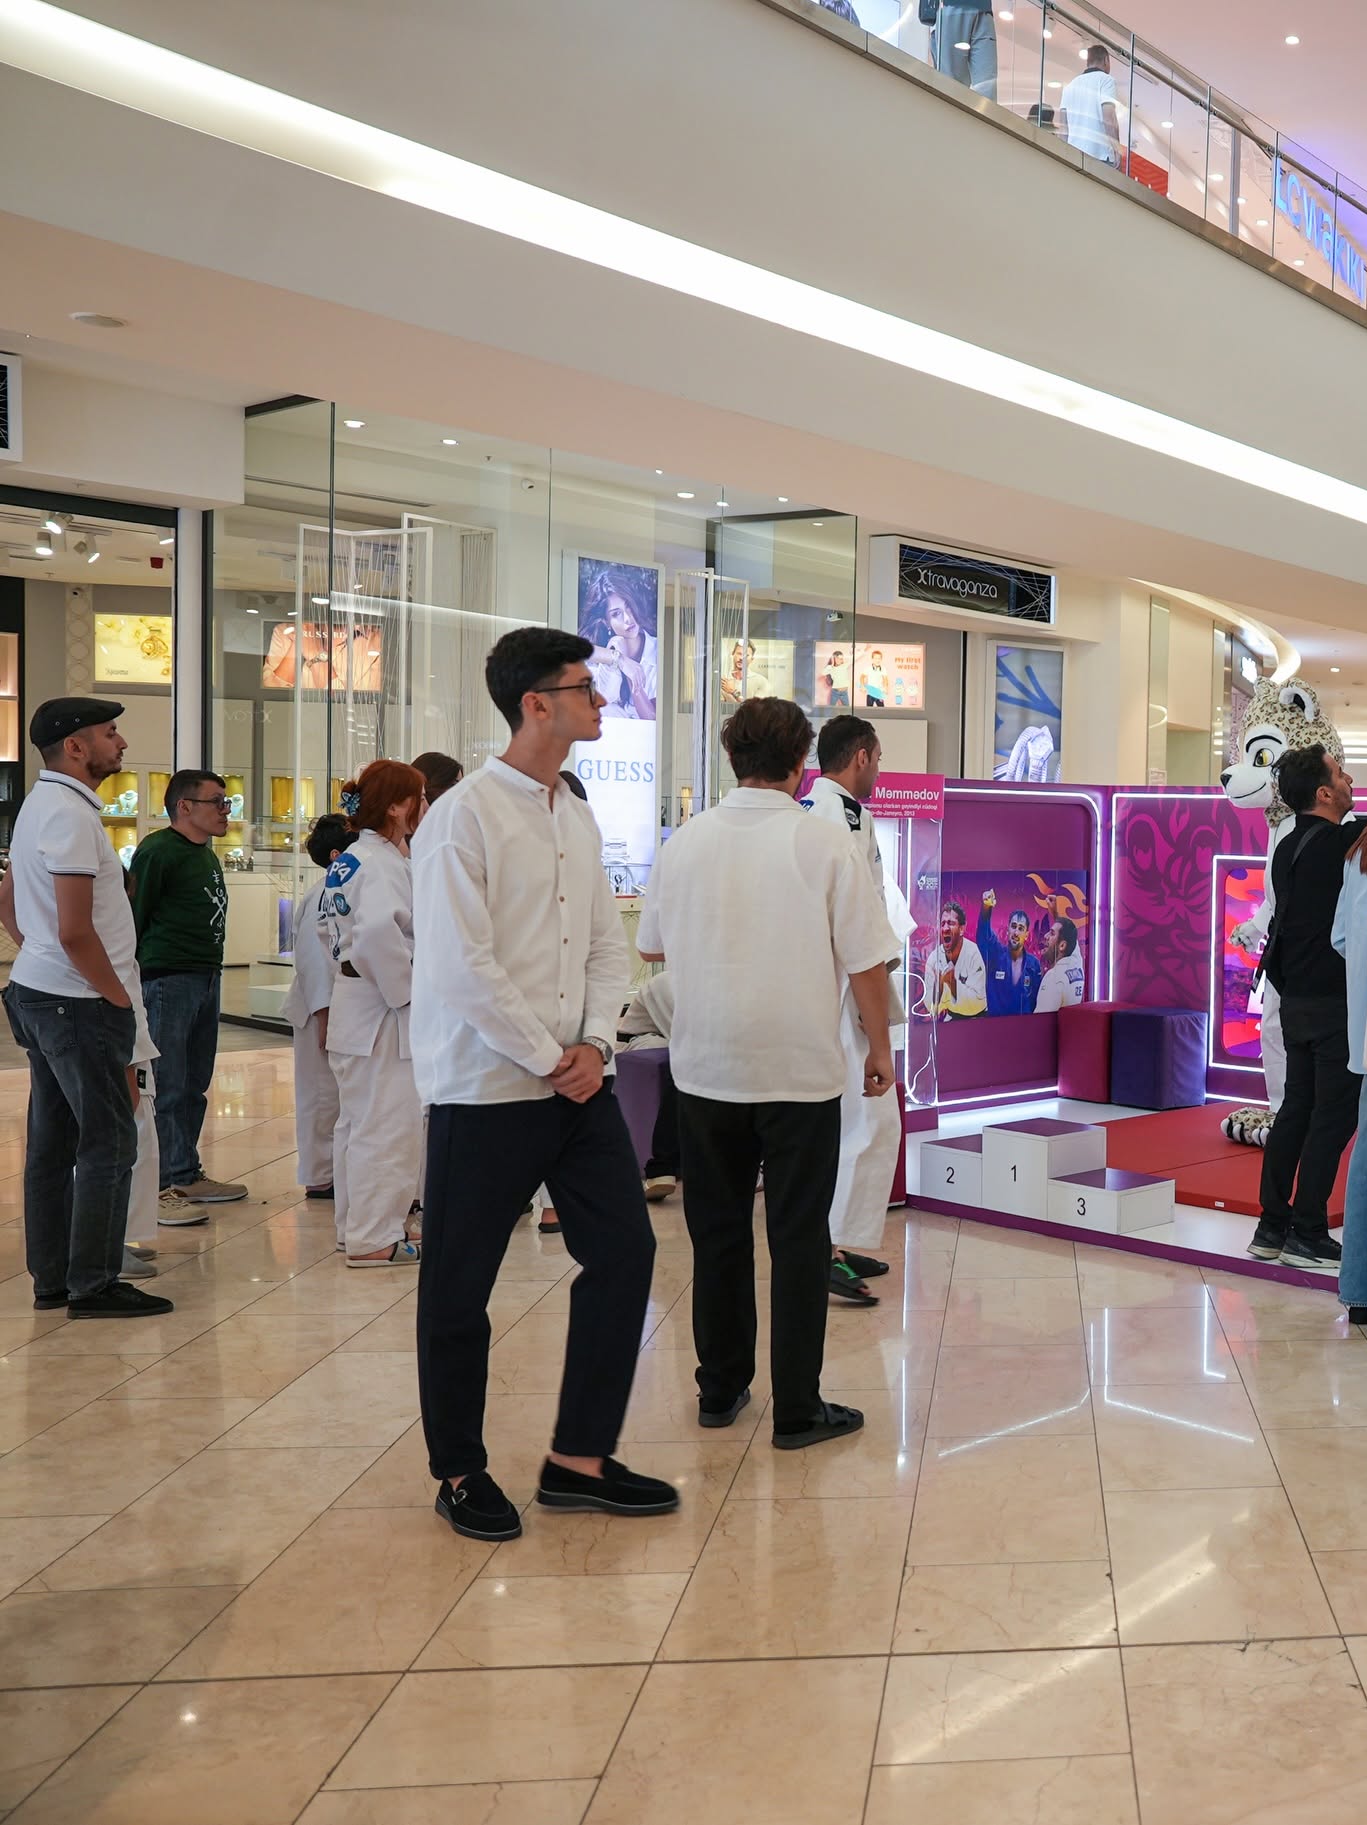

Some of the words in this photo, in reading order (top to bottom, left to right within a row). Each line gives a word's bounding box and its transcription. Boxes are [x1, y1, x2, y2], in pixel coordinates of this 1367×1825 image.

[917, 568, 998, 598] Xtravaganza
[577, 758, 654, 782] GUESS
[875, 786, 940, 800] Məmmədov
[946, 1166, 955, 1184] 2
[1011, 1164, 1017, 1182] 1
[1076, 1197, 1086, 1215] 3
